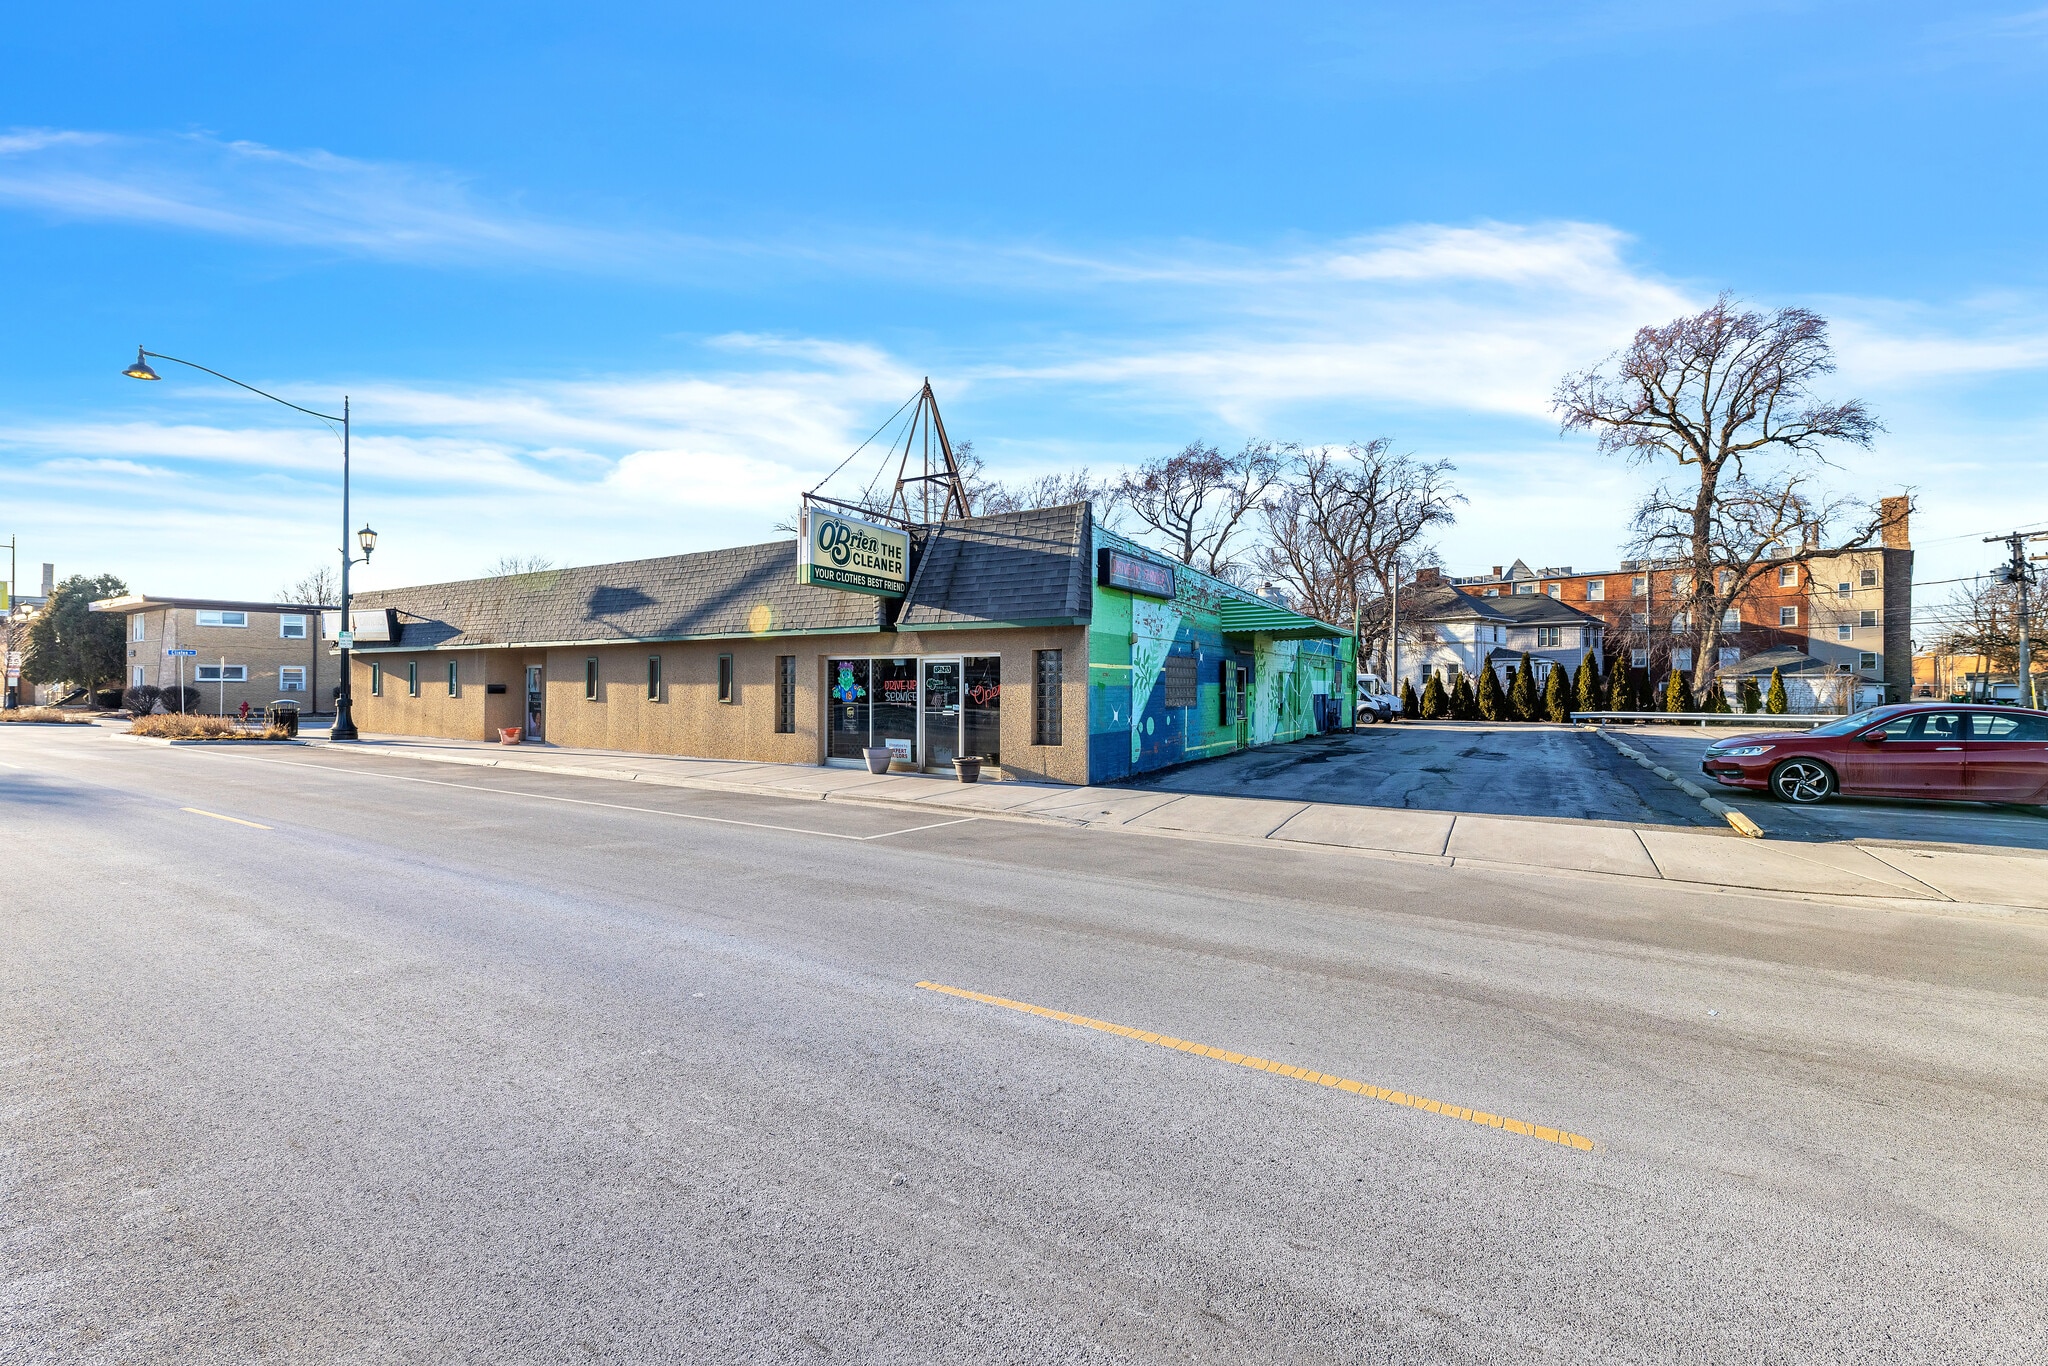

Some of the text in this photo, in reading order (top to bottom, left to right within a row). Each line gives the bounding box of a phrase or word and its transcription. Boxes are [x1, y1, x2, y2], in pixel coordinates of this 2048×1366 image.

[818, 519, 902, 567] O'Brien THE
[852, 552, 902, 574] CLEANER
[814, 567, 905, 592] YOUR CLOTHES BEST FRIEND
